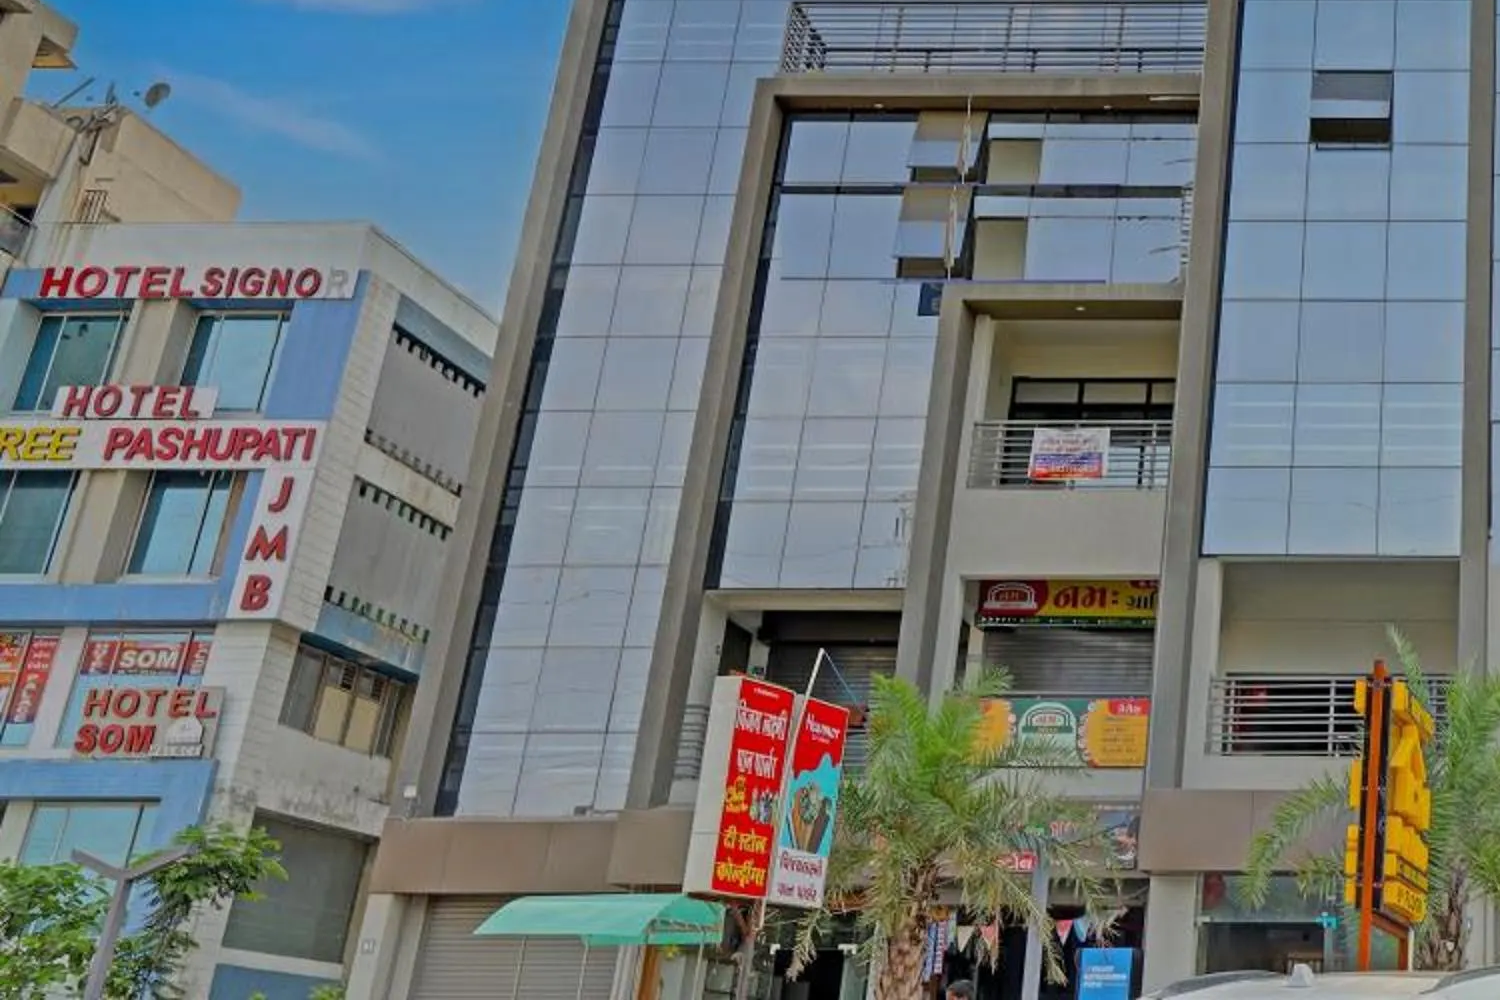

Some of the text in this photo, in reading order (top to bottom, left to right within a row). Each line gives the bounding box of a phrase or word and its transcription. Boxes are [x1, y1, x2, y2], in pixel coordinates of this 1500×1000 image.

[39, 266, 194, 298] HOTEL
[62, 385, 200, 418] HOTEL
[0, 426, 317, 462] REE PASHUPATI
[119, 649, 178, 669] SOM
[83, 688, 218, 719] HOTEL
[74, 723, 157, 754] SOM
